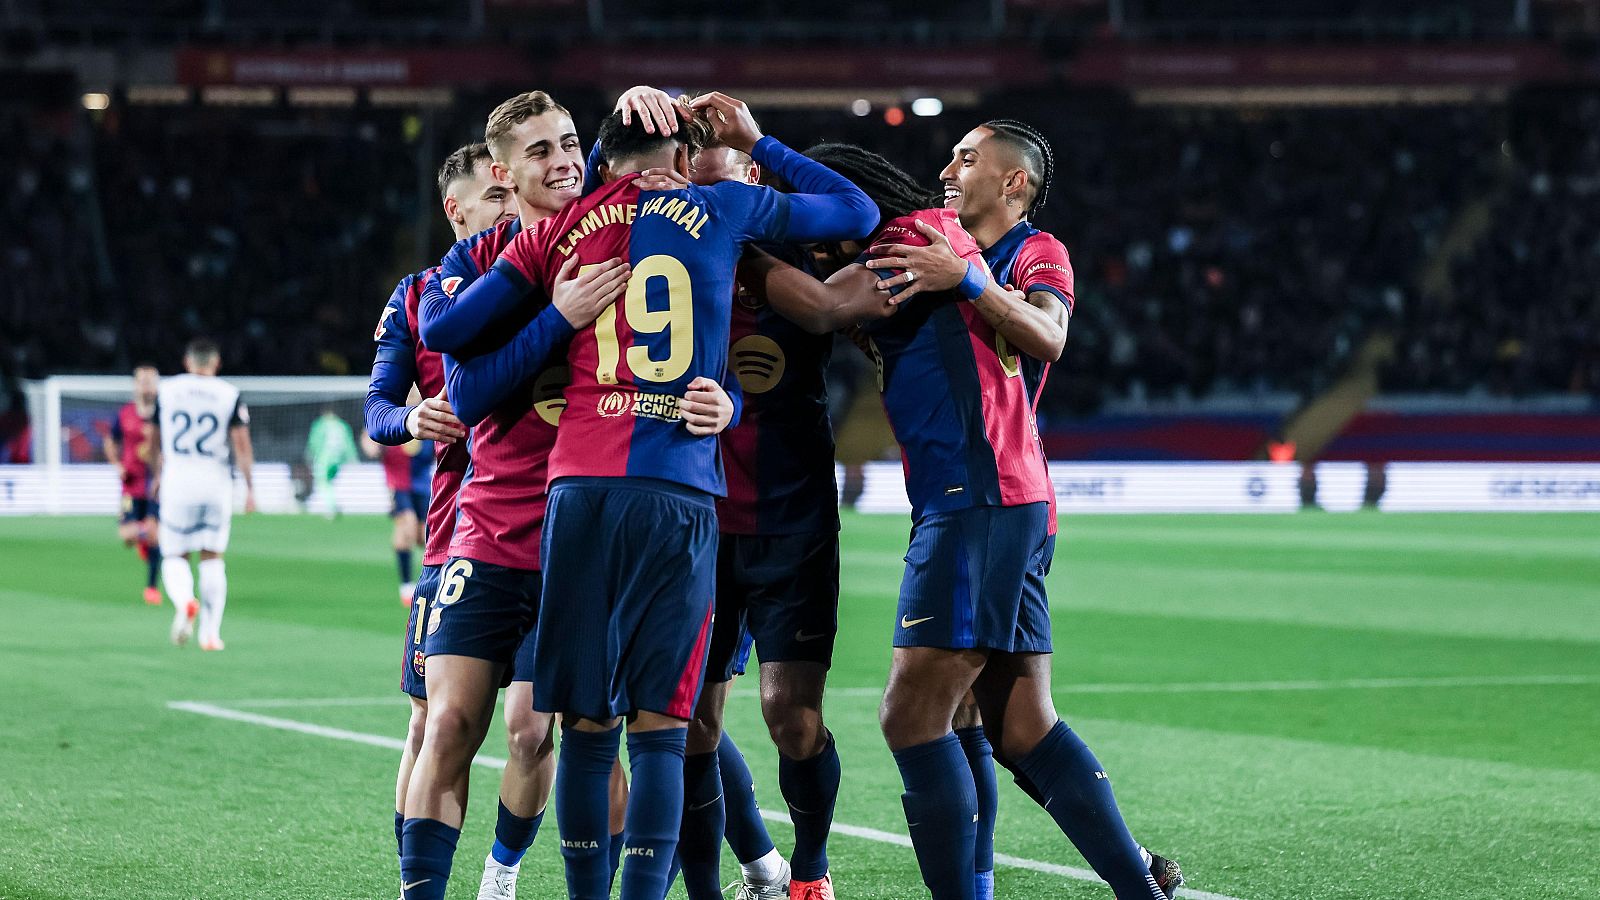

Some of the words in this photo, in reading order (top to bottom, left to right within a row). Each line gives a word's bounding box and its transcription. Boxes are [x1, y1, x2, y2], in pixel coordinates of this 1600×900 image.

[556, 203, 638, 257] LAMINE
[640, 196, 709, 240] YAMAL
[577, 254, 694, 385] 19
[171, 409, 218, 456] 22
[630, 401, 682, 419] ACNUR
